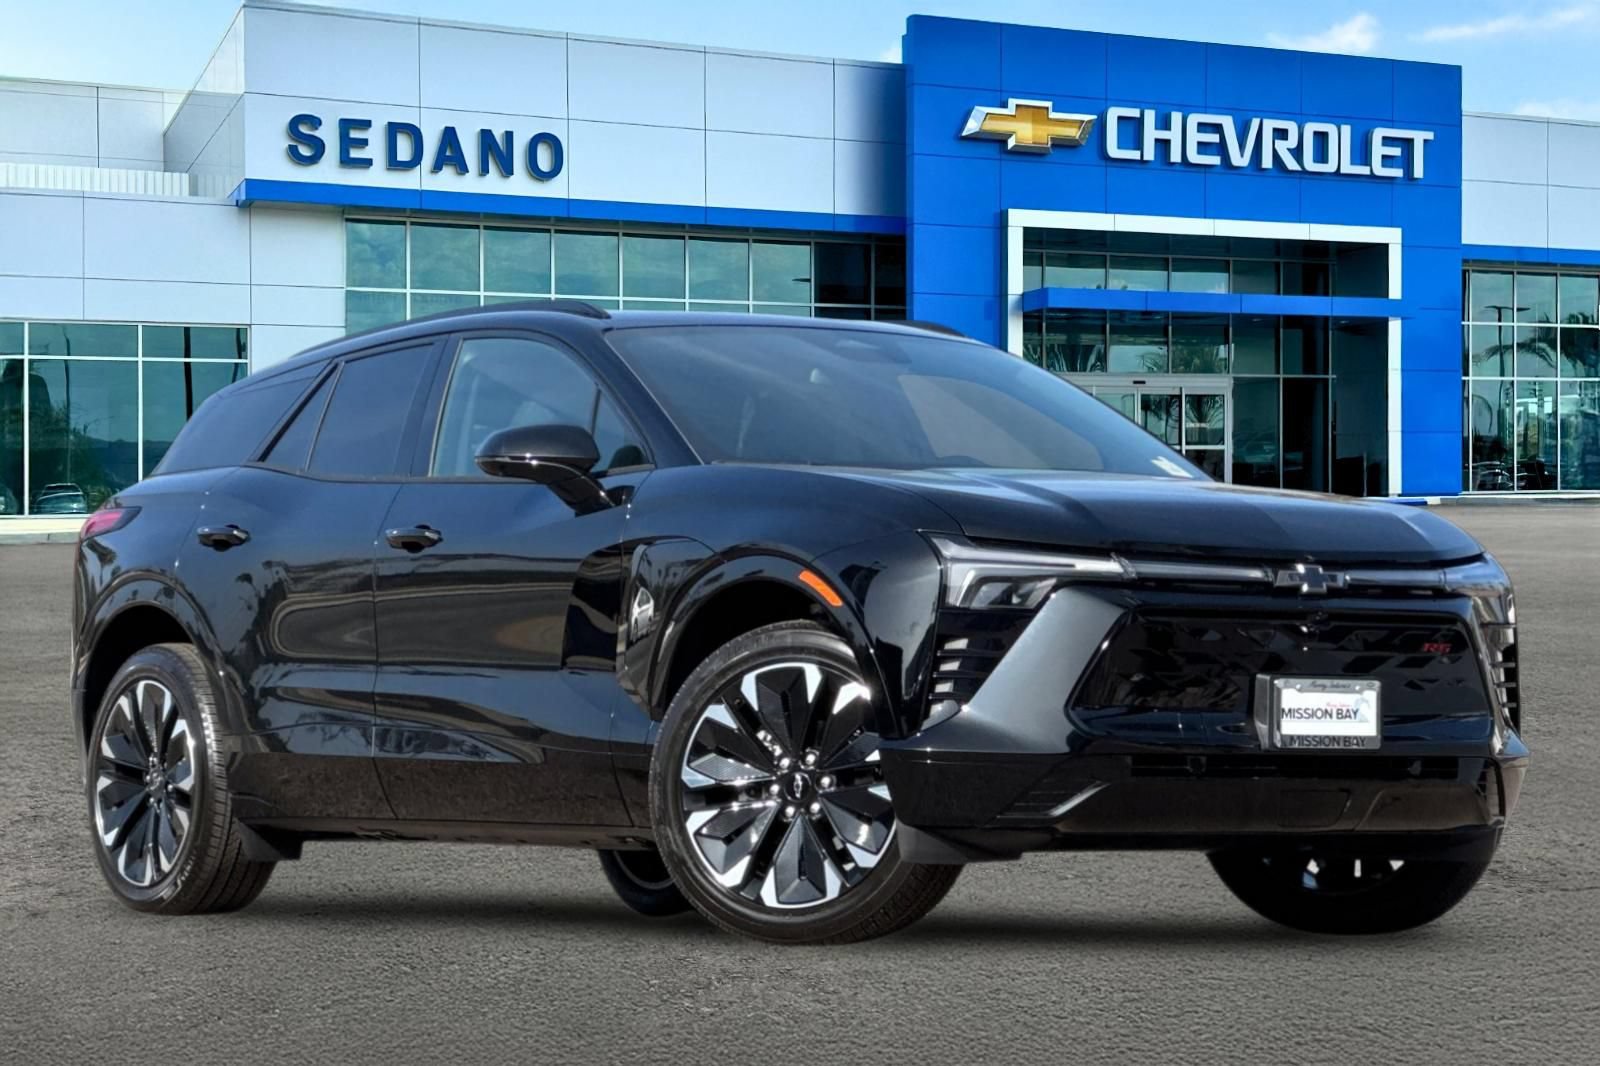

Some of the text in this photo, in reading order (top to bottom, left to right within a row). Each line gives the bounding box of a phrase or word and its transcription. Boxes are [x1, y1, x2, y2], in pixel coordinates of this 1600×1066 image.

[287, 113, 564, 182] SEDANO
[1105, 106, 1435, 179] CHEVROLET
[1281, 707, 1360, 720] MISSION BAY
[1289, 735, 1367, 748] MISSION BAY
